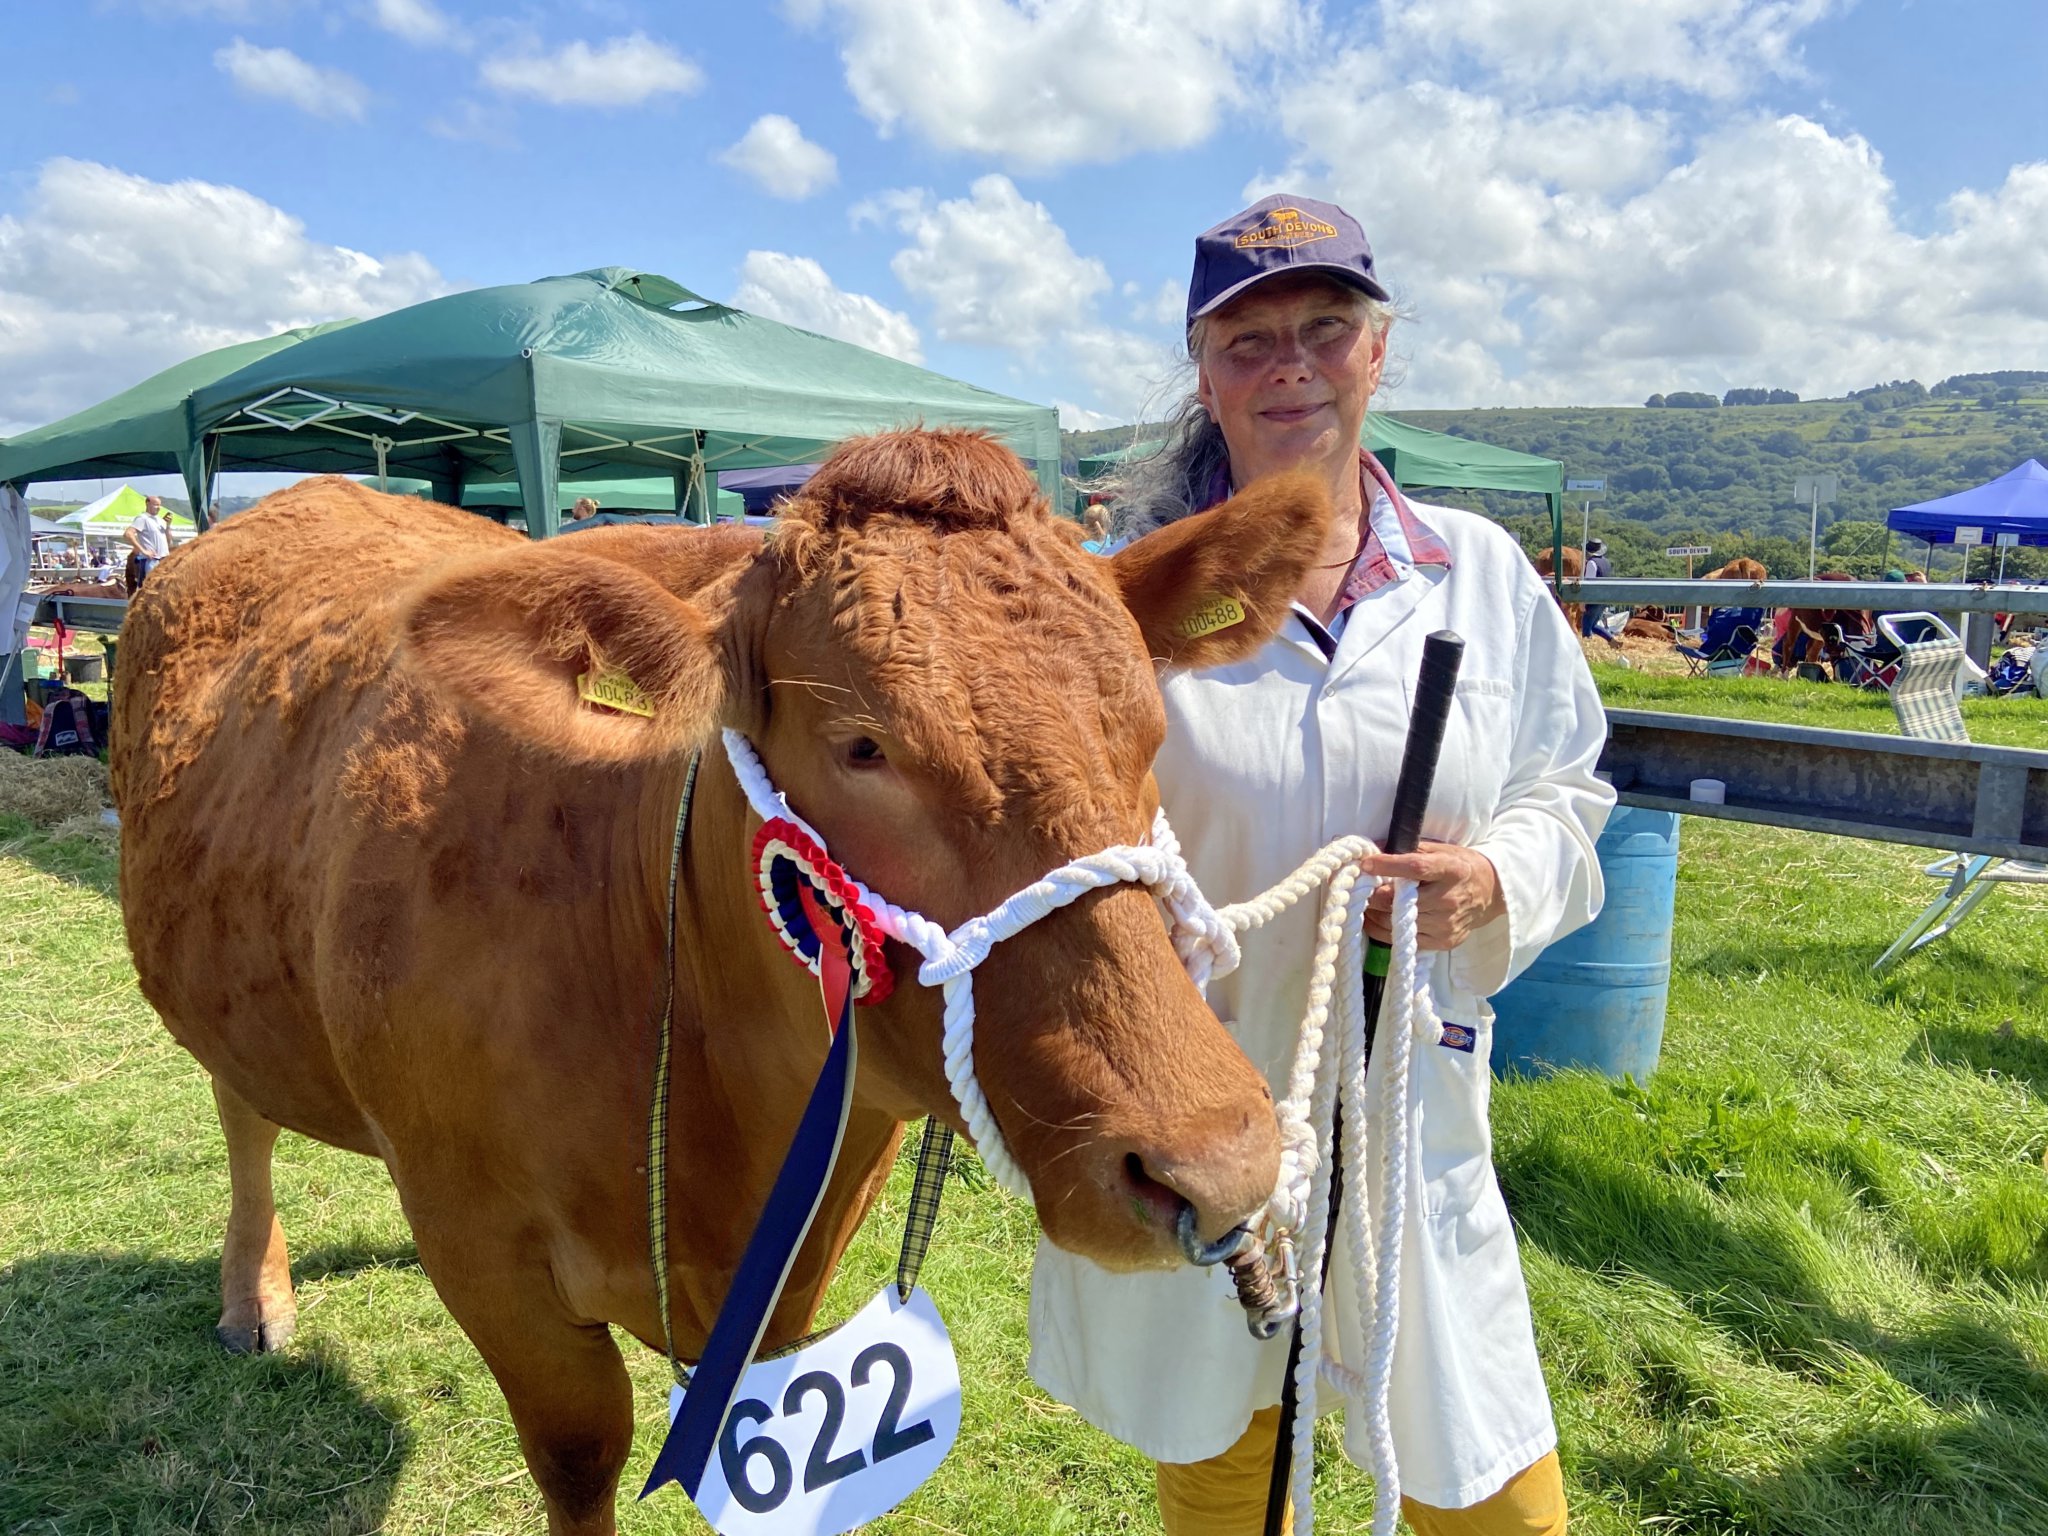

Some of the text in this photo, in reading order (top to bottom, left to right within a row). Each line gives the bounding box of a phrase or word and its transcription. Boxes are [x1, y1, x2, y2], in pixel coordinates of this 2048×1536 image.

[1240, 226, 1282, 245] SOUTH
[1286, 221, 1334, 235] DEVONS
[718, 1342, 936, 1513] 622
